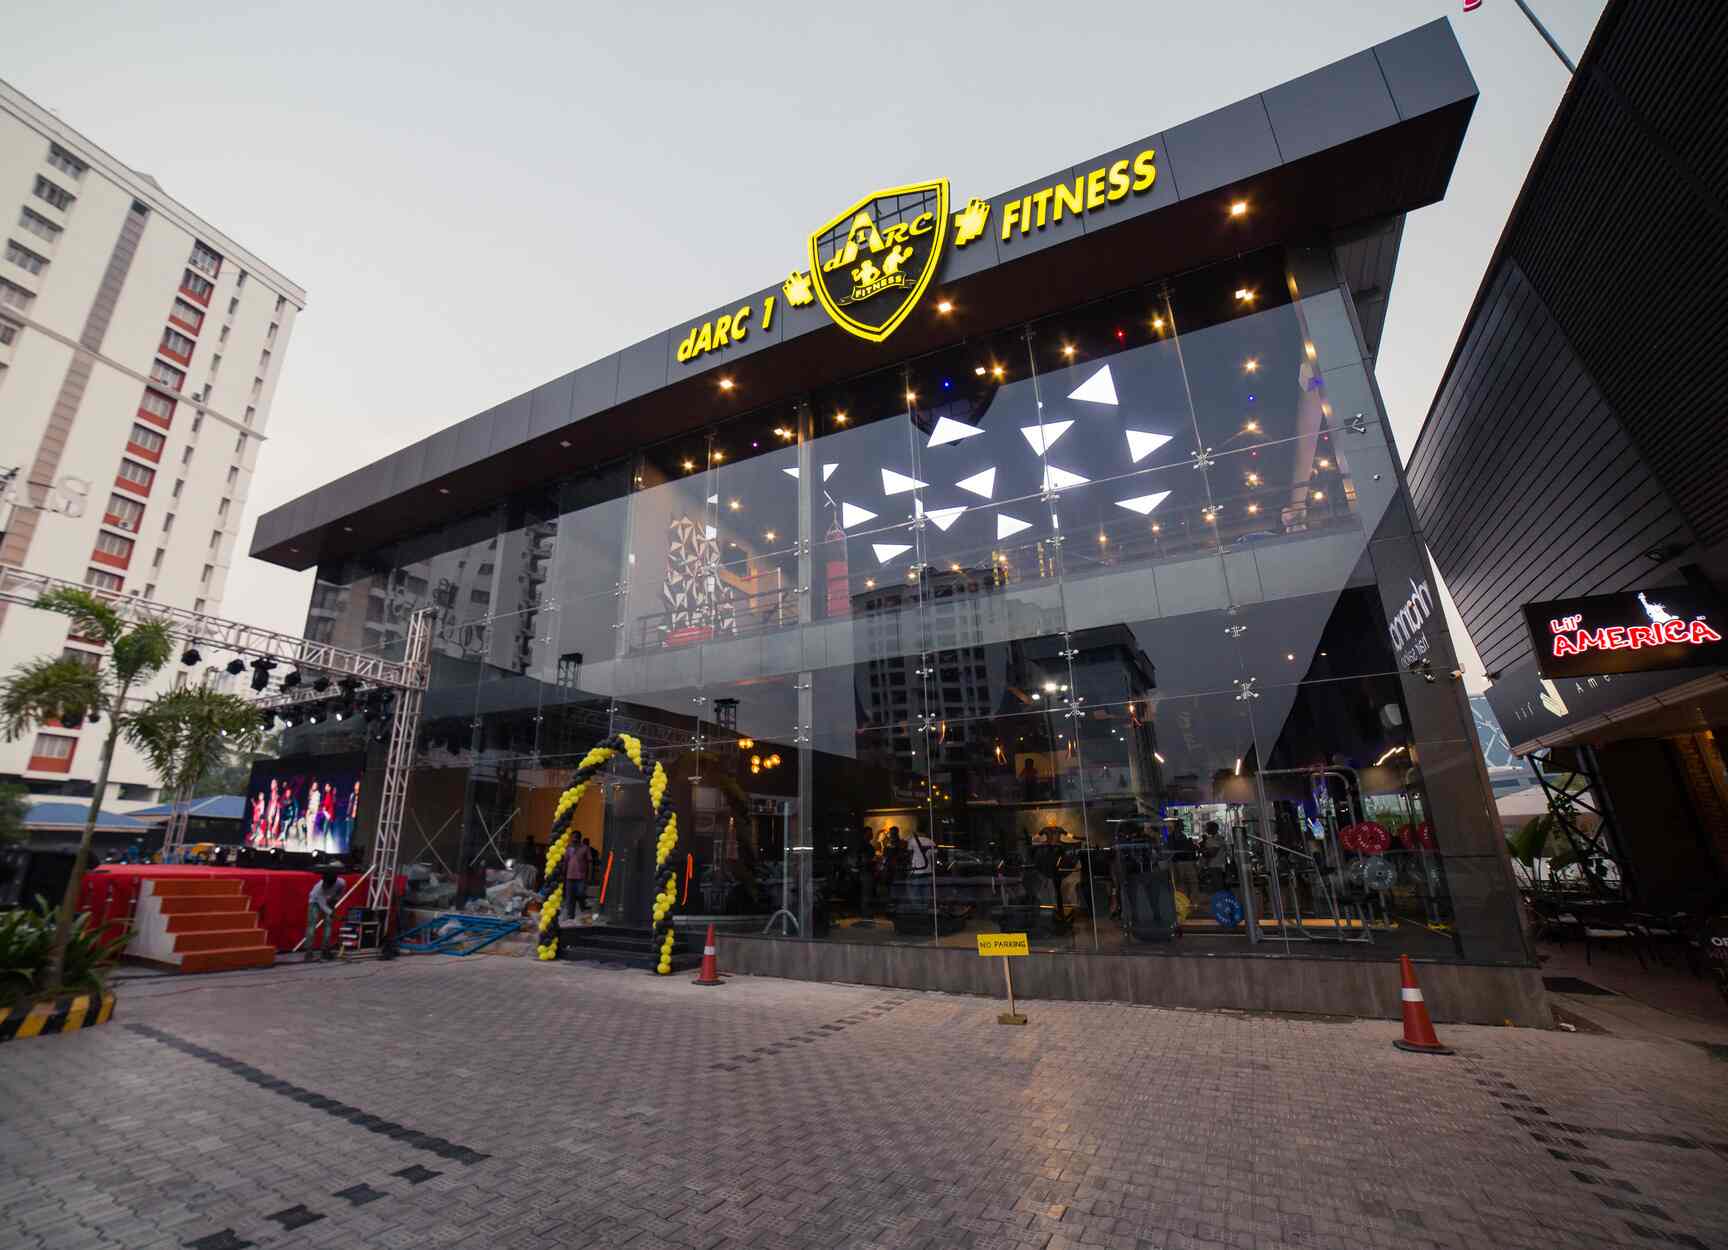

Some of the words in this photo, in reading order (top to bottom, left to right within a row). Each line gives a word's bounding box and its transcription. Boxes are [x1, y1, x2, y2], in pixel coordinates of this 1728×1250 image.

[676, 305, 751, 363] dARC
[763, 295, 776, 330] 1
[1001, 149, 1157, 241] FITNESS
[855, 275, 903, 299] FITNESS
[1553, 621, 1722, 657] AMERICA
[993, 940, 1027, 949] PARKING
